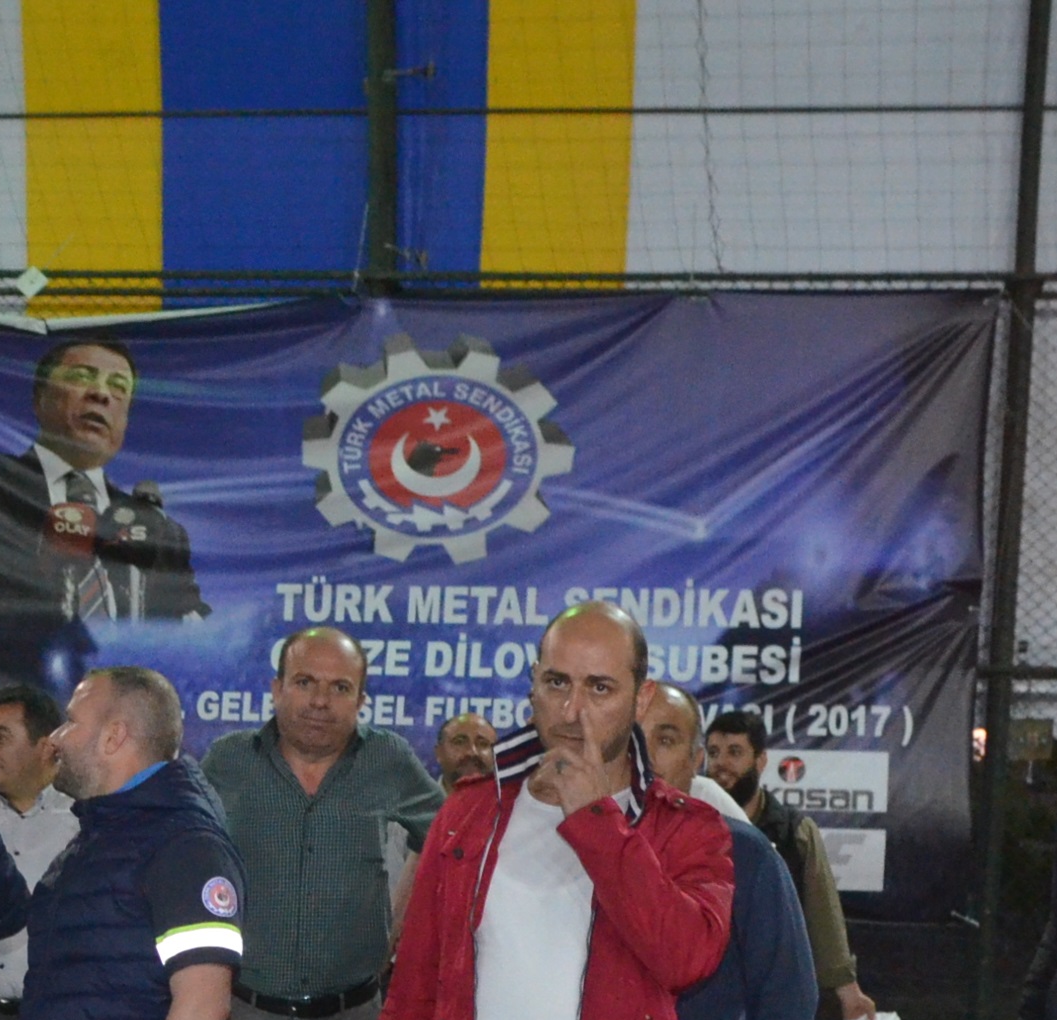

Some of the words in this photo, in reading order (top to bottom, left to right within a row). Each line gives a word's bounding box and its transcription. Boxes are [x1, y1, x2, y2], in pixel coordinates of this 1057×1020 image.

[342, 416, 374, 474] TÜRK
[367, 382, 446, 419] METAL
[454, 383, 533, 475] SENDİKASI
[276, 576, 393, 624] TÜRK
[407, 585, 548, 626] METAL
